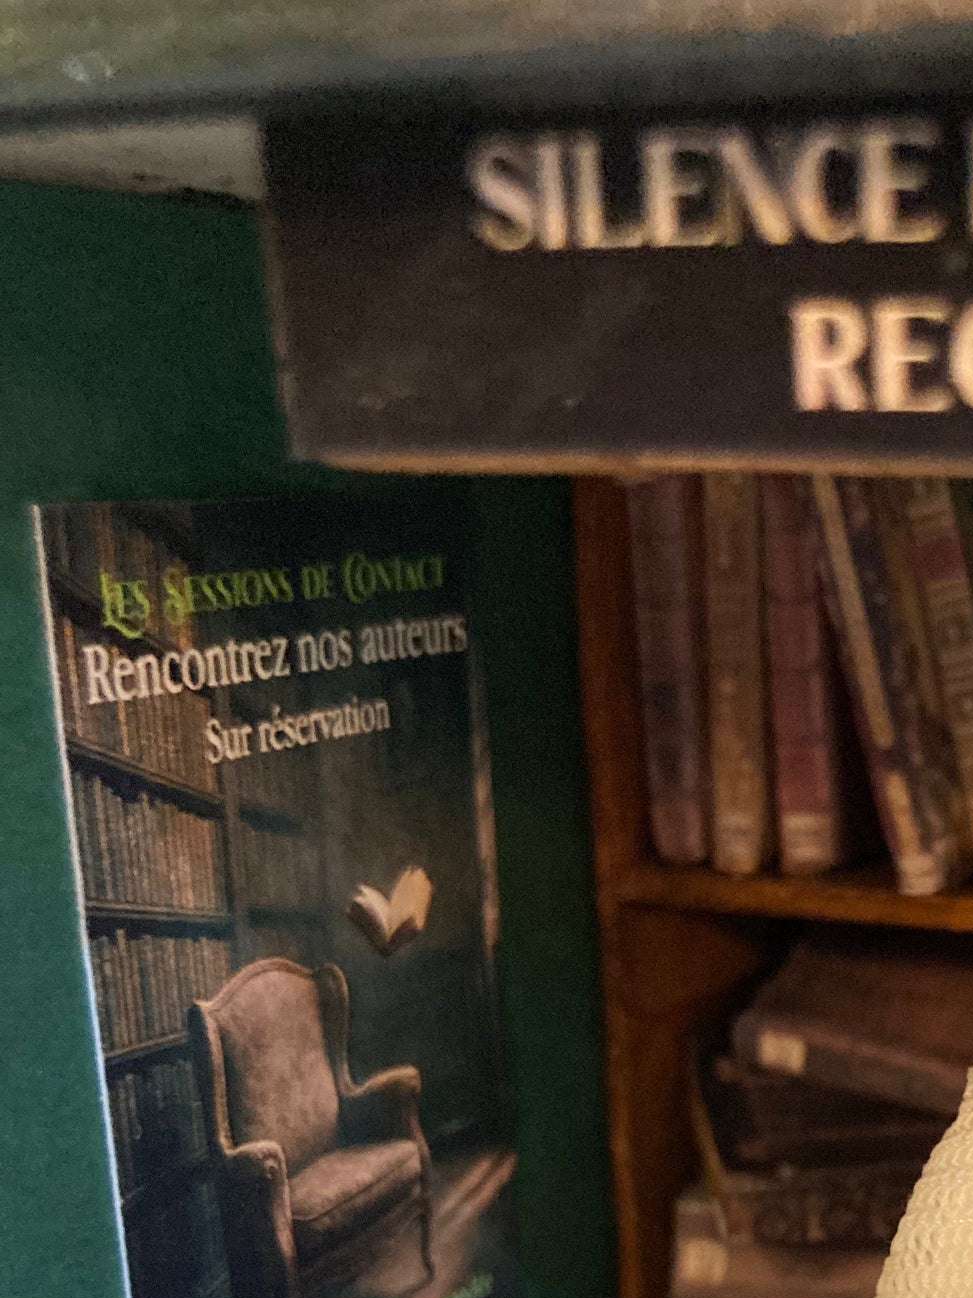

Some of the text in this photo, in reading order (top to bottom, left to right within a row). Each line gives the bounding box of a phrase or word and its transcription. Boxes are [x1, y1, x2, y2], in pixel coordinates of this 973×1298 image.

[468, 120, 945, 252] SILENCE
[83, 615, 468, 706] Rencontrez nos auteurs
[205, 696, 391, 765] Sur réservation
